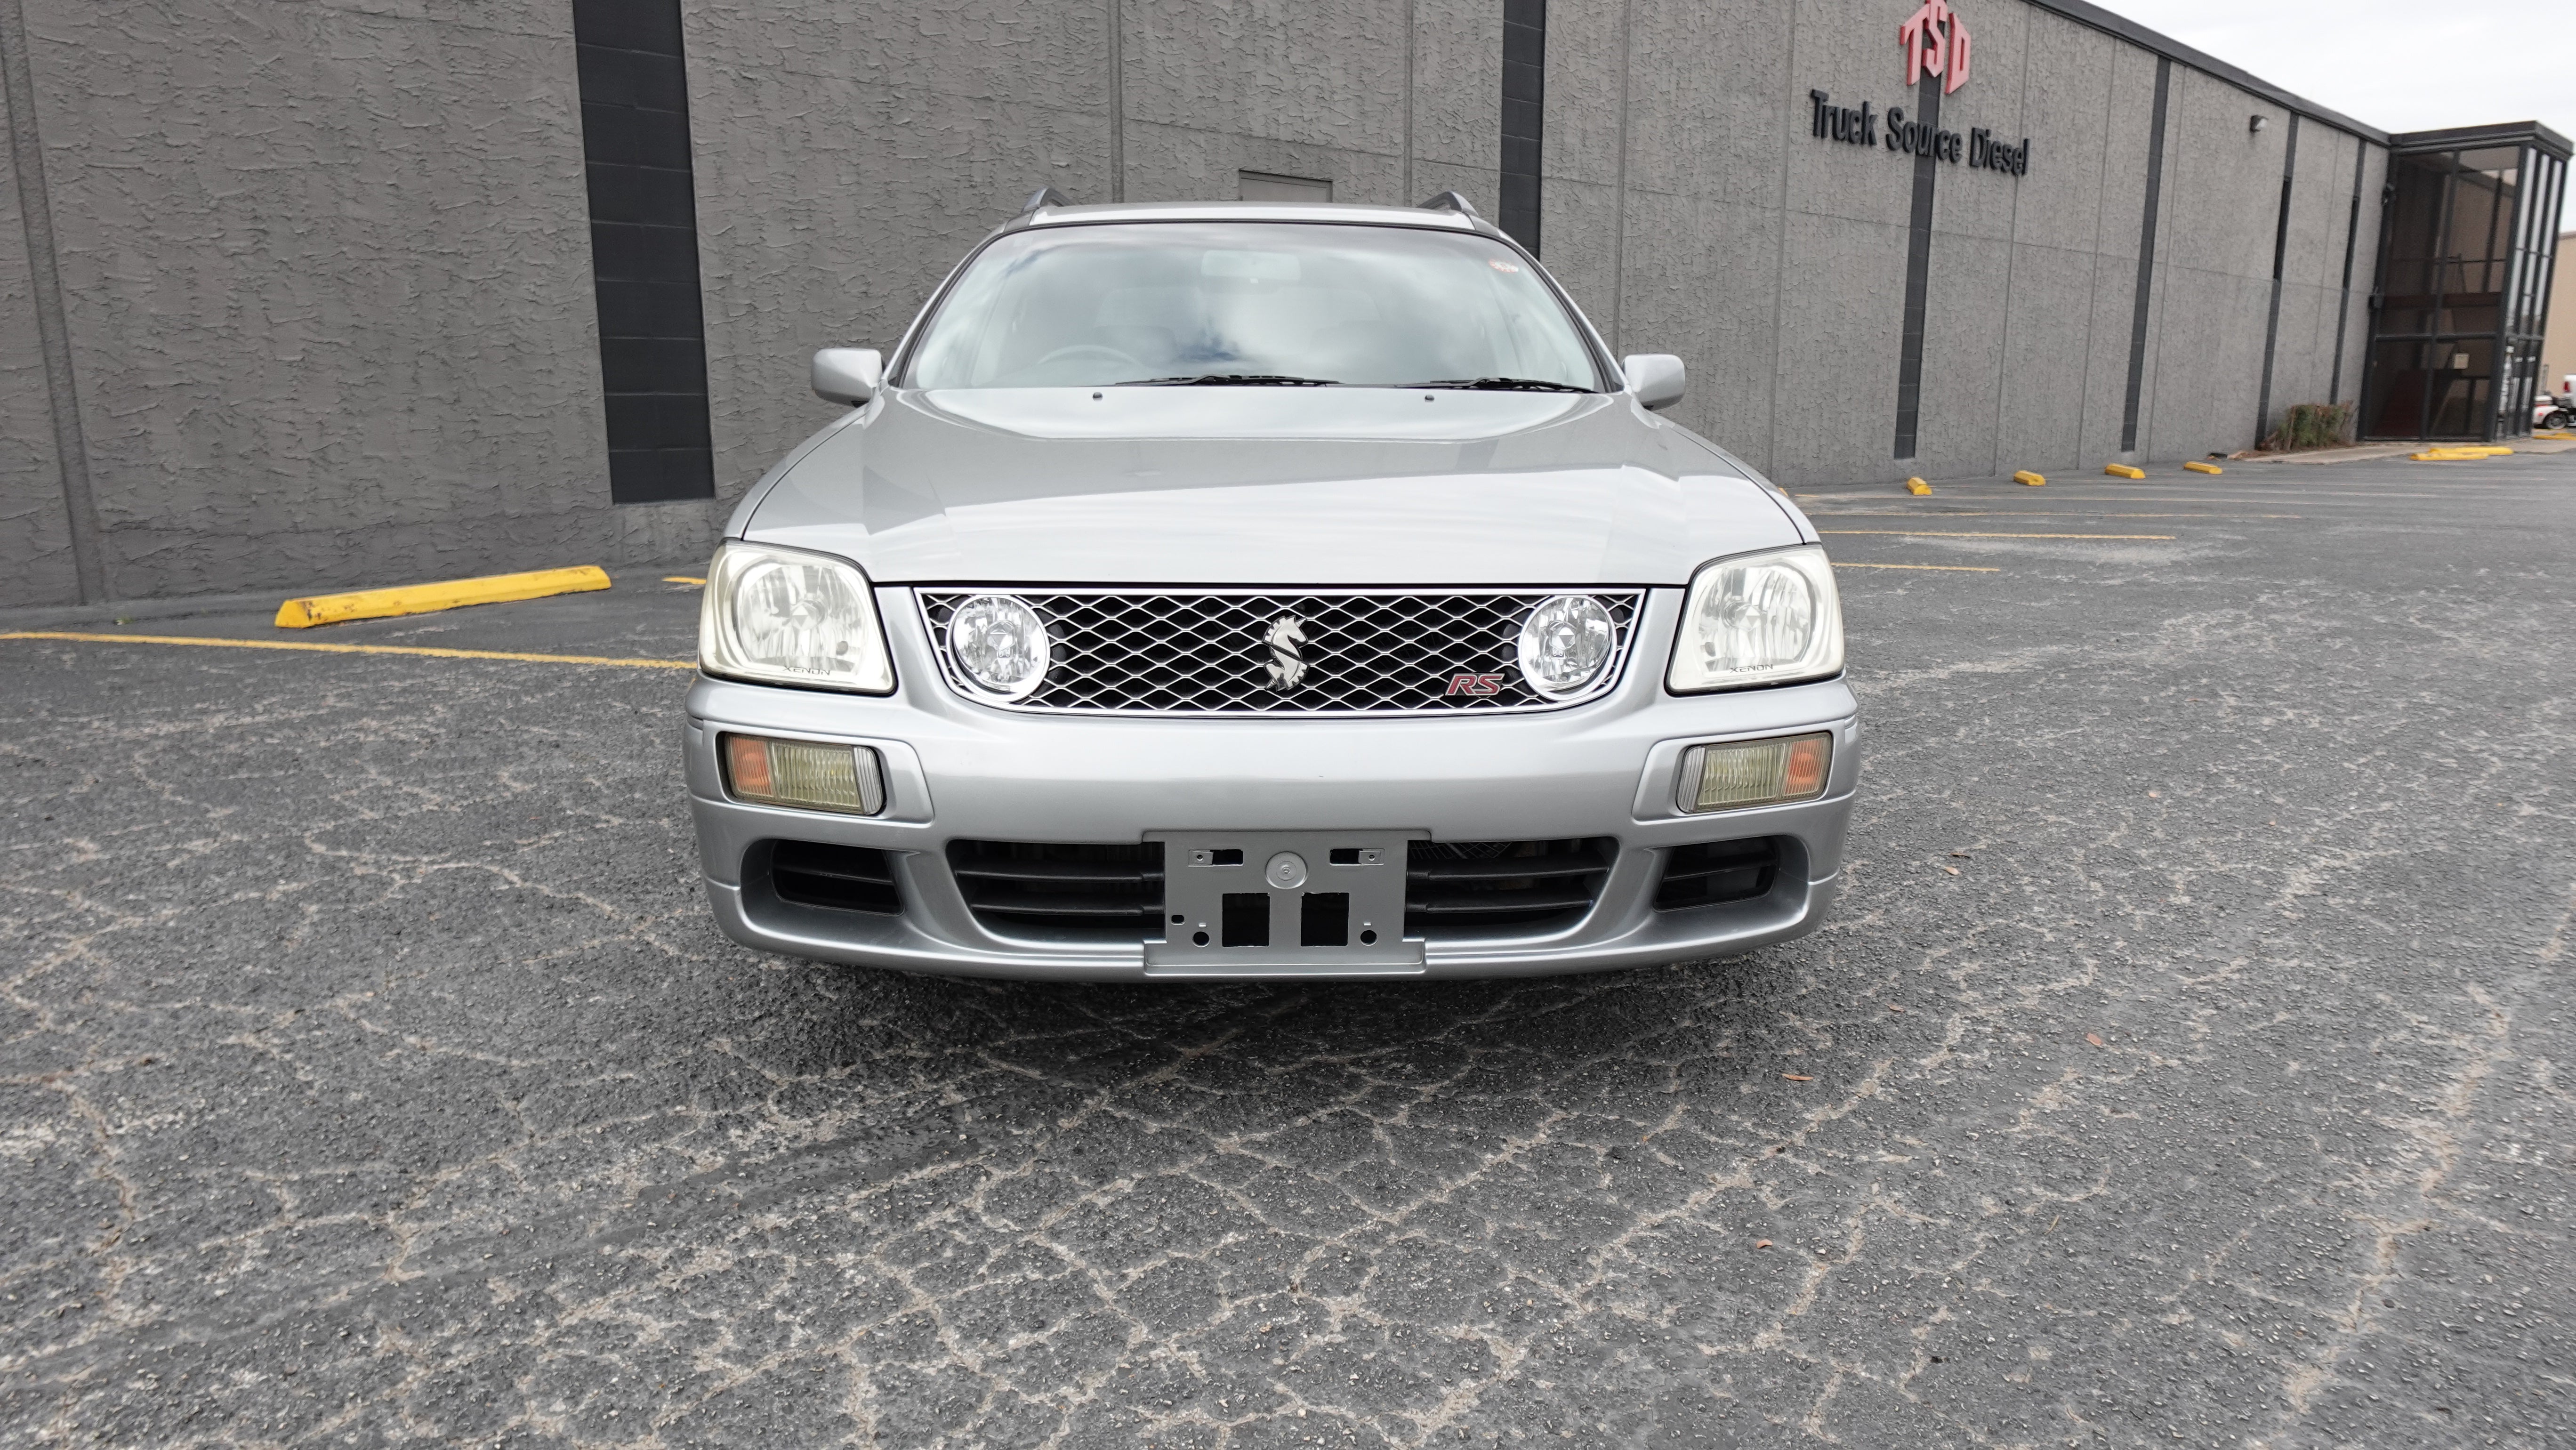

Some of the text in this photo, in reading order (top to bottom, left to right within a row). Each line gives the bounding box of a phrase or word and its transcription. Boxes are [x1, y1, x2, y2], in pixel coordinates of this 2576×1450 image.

[1900, 0, 1972, 94] TSD
[1811, 89, 2030, 176] Truck Source Diesel
[783, 666, 830, 676] XENON
[1729, 664, 1773, 674] XENON
[1445, 674, 1505, 696] RS
